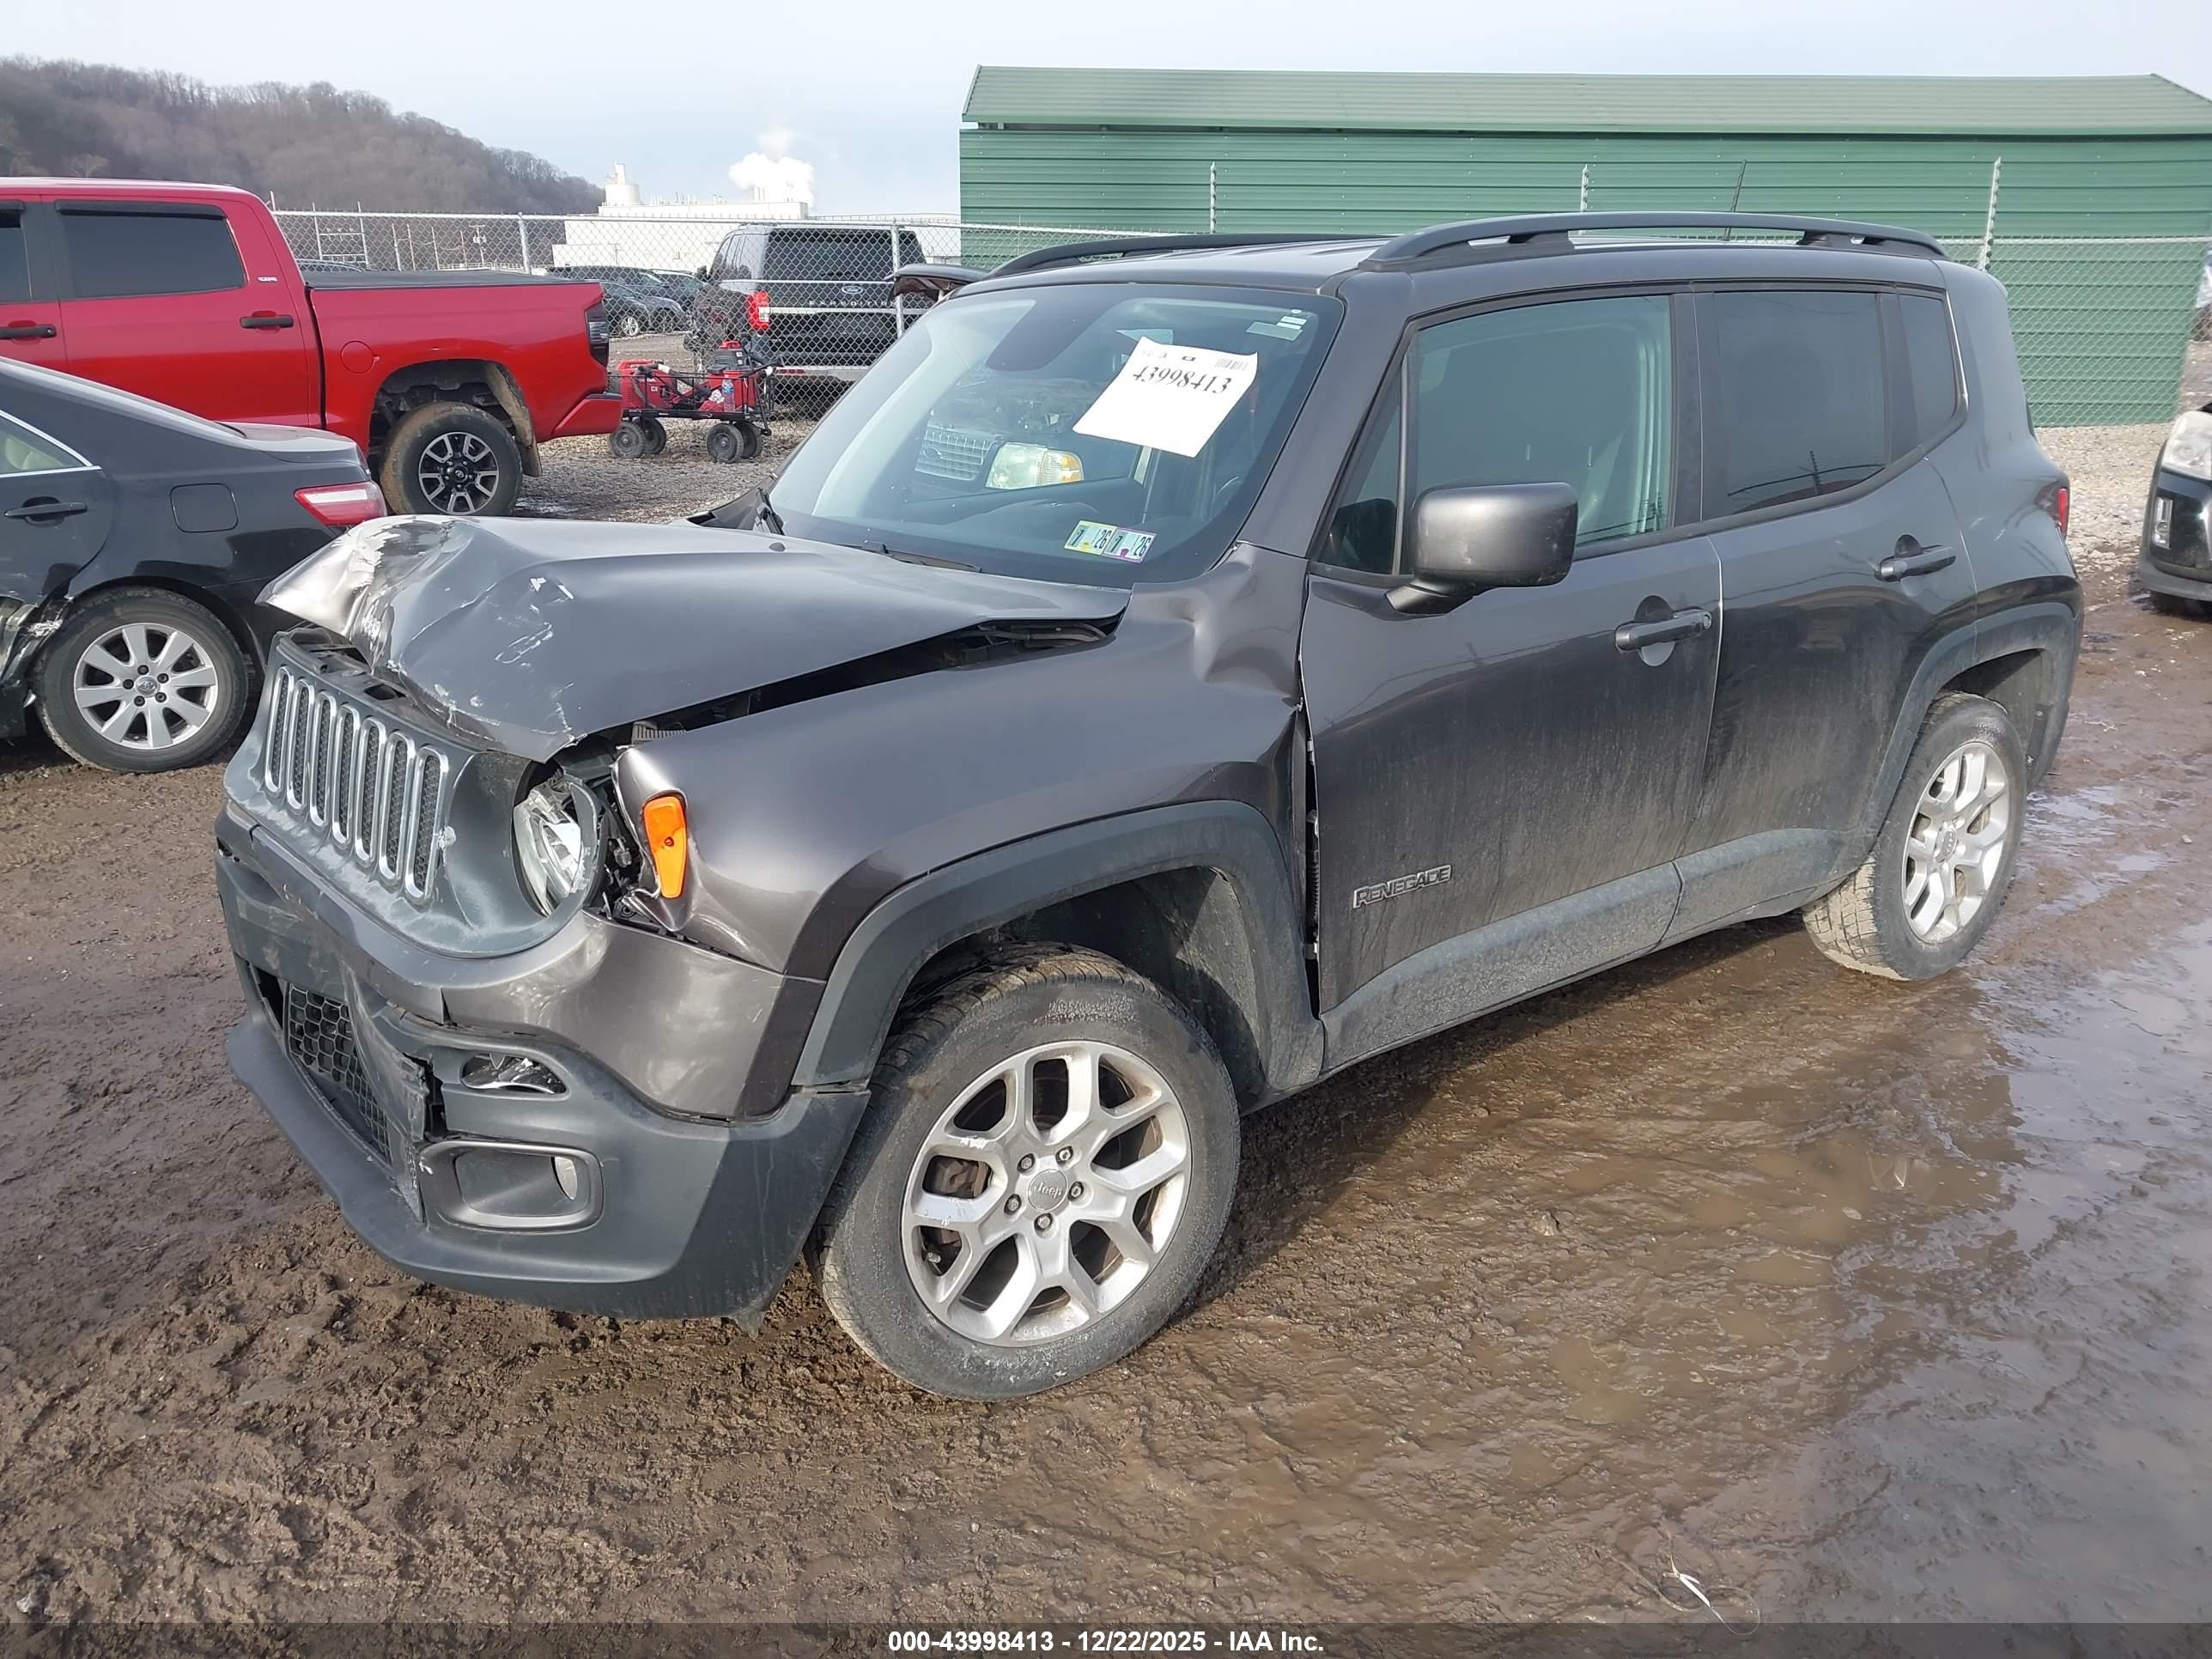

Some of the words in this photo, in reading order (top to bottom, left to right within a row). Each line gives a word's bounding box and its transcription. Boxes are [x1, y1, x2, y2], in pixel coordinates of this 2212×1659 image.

[1133, 365, 1232, 394] 43998413
[1094, 530, 1112, 550] 26
[1133, 536, 1152, 556] 26
[1352, 864, 1452, 908] RENEGADE
[1033, 1182, 1062, 1199] Jeep
